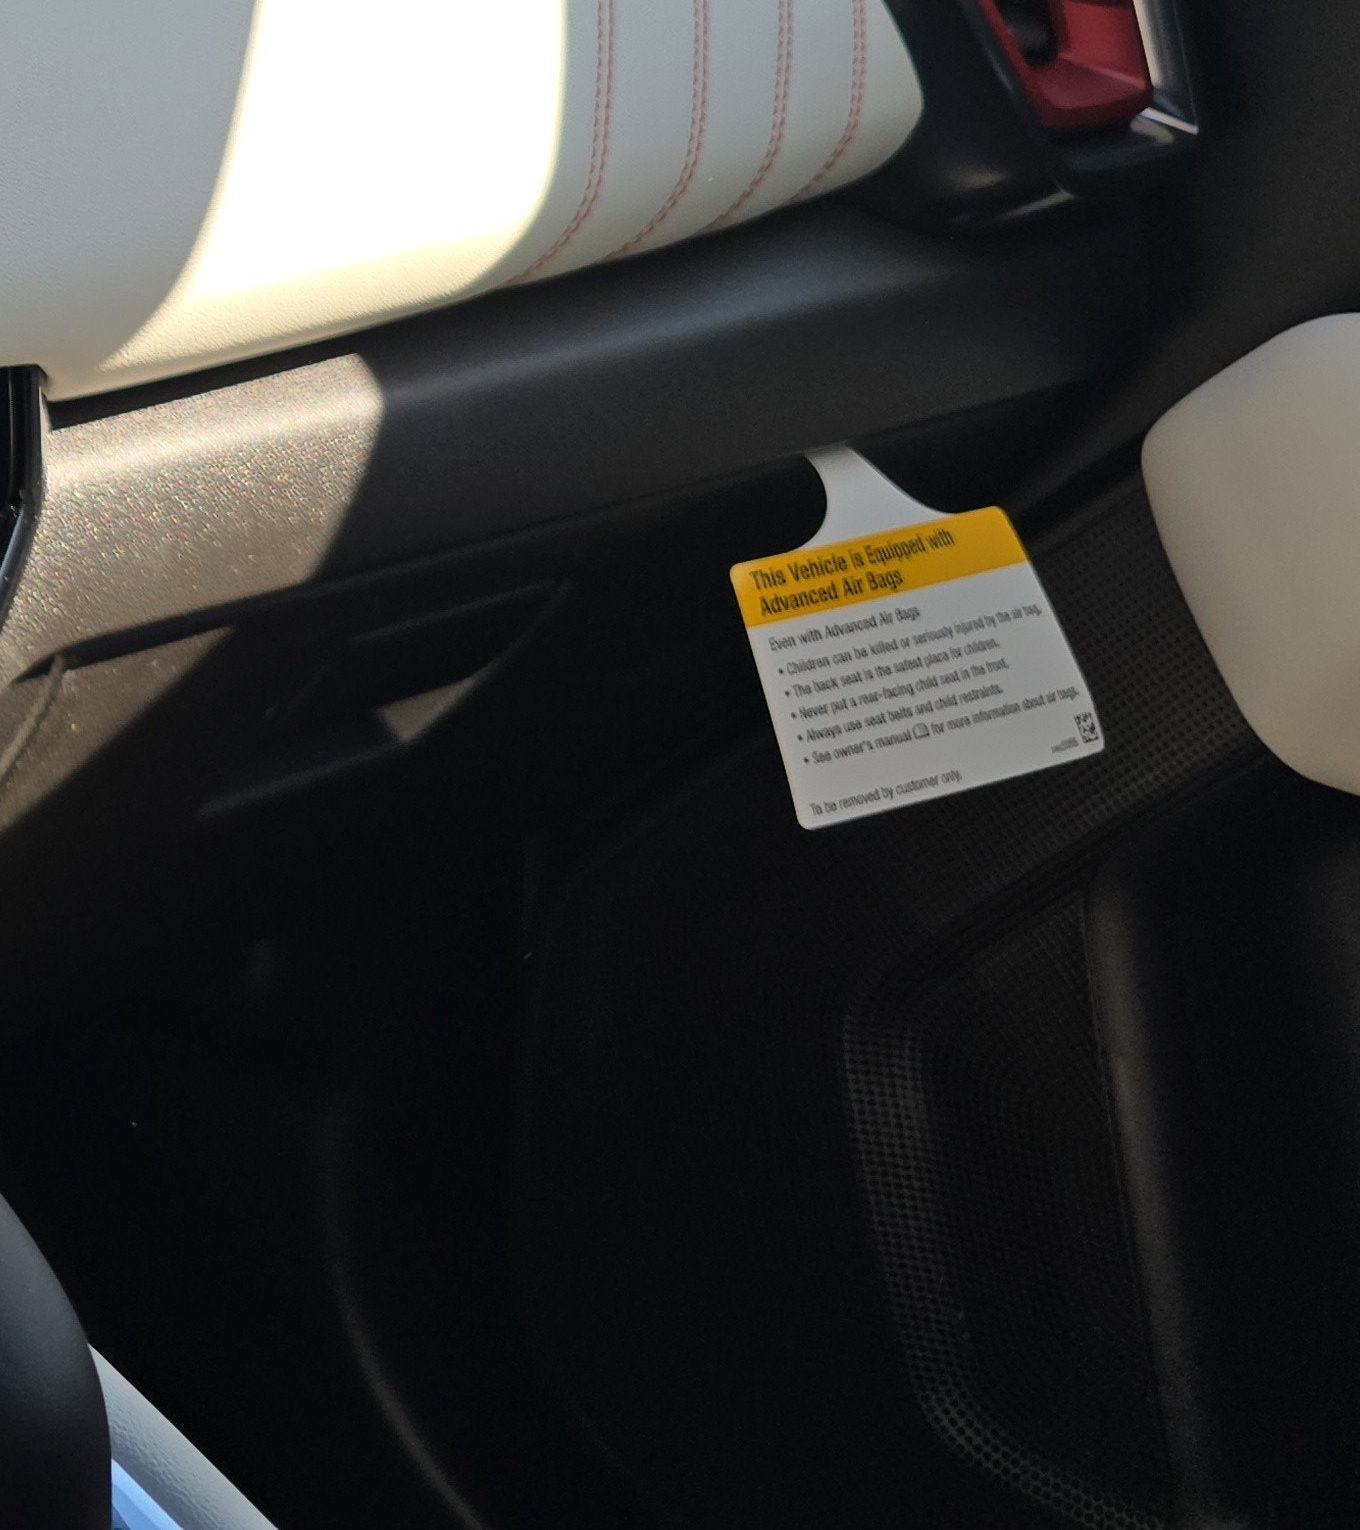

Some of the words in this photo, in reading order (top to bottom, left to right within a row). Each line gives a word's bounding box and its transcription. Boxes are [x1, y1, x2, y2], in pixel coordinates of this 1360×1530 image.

[749, 567, 787, 590] This
[788, 552, 848, 582] Vehicle
[864, 535, 927, 564] Equipped
[928, 528, 955, 552] with
[760, 582, 838, 616] Advanced
[843, 576, 863, 597] Air
[866, 570, 904, 591] Bags
[768, 636, 796, 651] Even
[799, 628, 822, 645] with
[825, 615, 877, 639] Advanced
[878, 611, 894, 625] Air
[895, 606, 920, 621] Bags
[786, 656, 830, 675] Children
[832, 651, 852, 665] can
[868, 639, 898, 655] killed
[792, 683, 812, 698] The
[799, 704, 828, 719] Never
[806, 724, 842, 743] Always
[812, 750, 832, 765] See
[875, 729, 912, 749] manual
[809, 802, 823, 816] To
[823, 800, 838, 813] be
[839, 788, 881, 810] removed
[880, 786, 894, 800] by
[895, 774, 939, 796] customer
